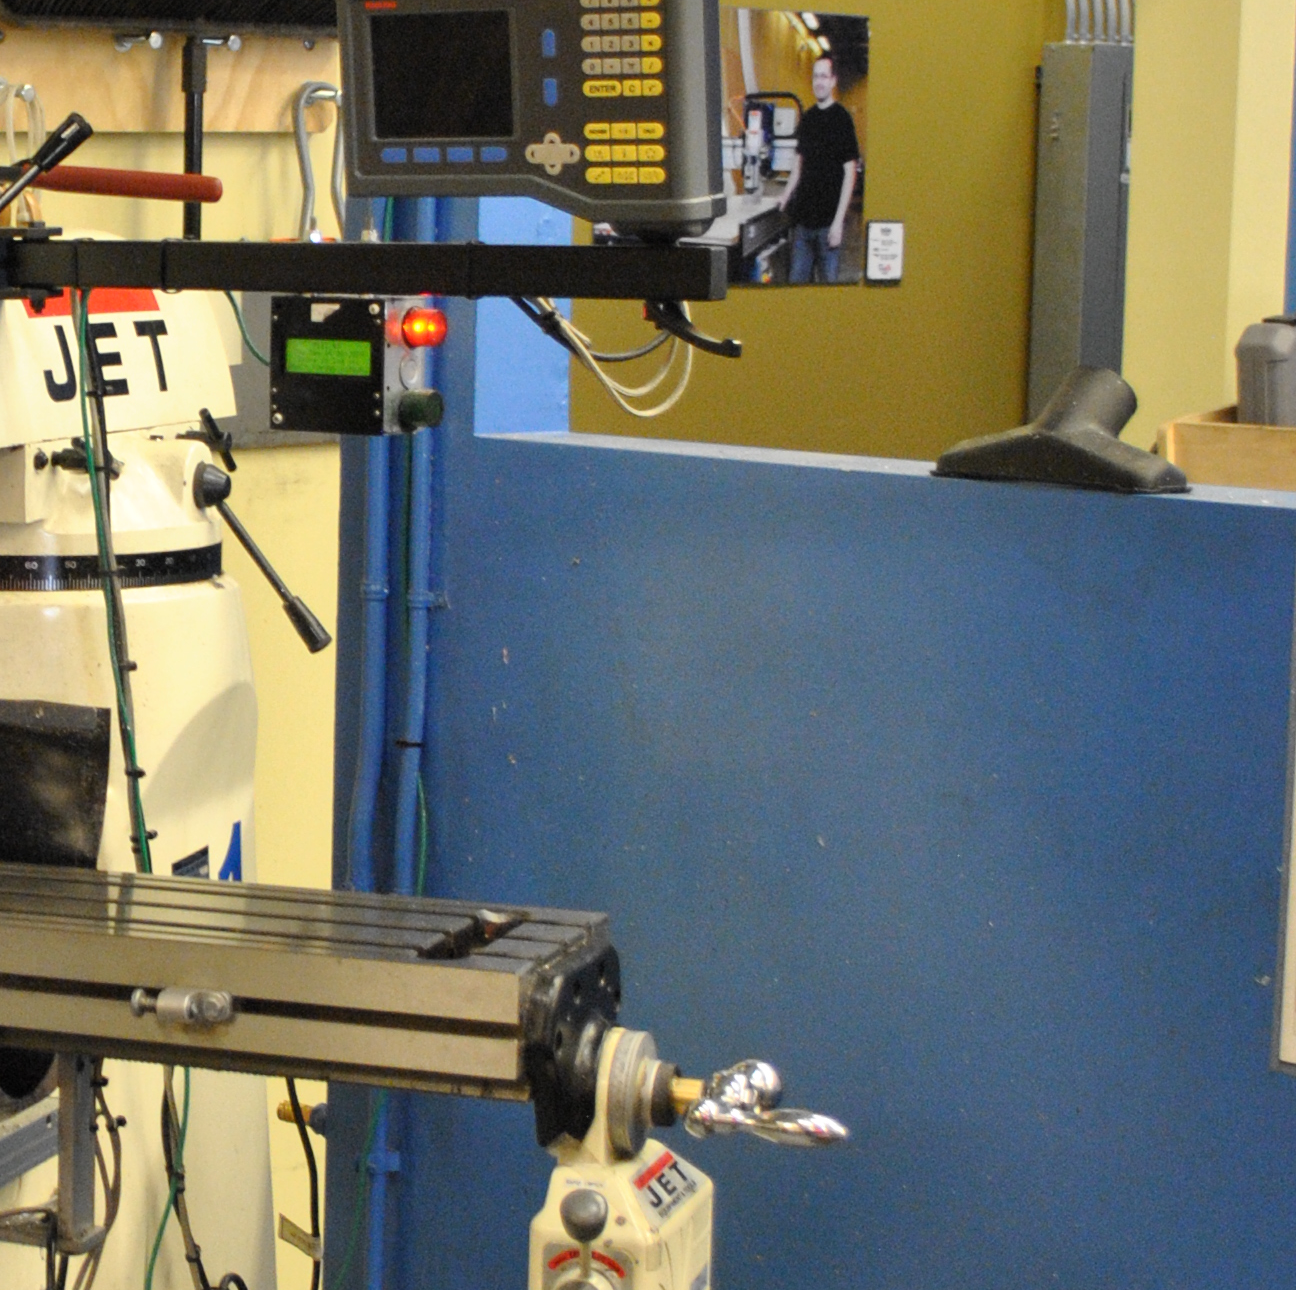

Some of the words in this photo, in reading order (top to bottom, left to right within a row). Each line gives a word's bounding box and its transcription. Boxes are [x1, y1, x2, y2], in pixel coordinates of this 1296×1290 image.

[589, 84, 616, 94] ENTER
[43, 319, 169, 403] JET
[24, 560, 39, 570] 60
[649, 1160, 688, 1208] JET
